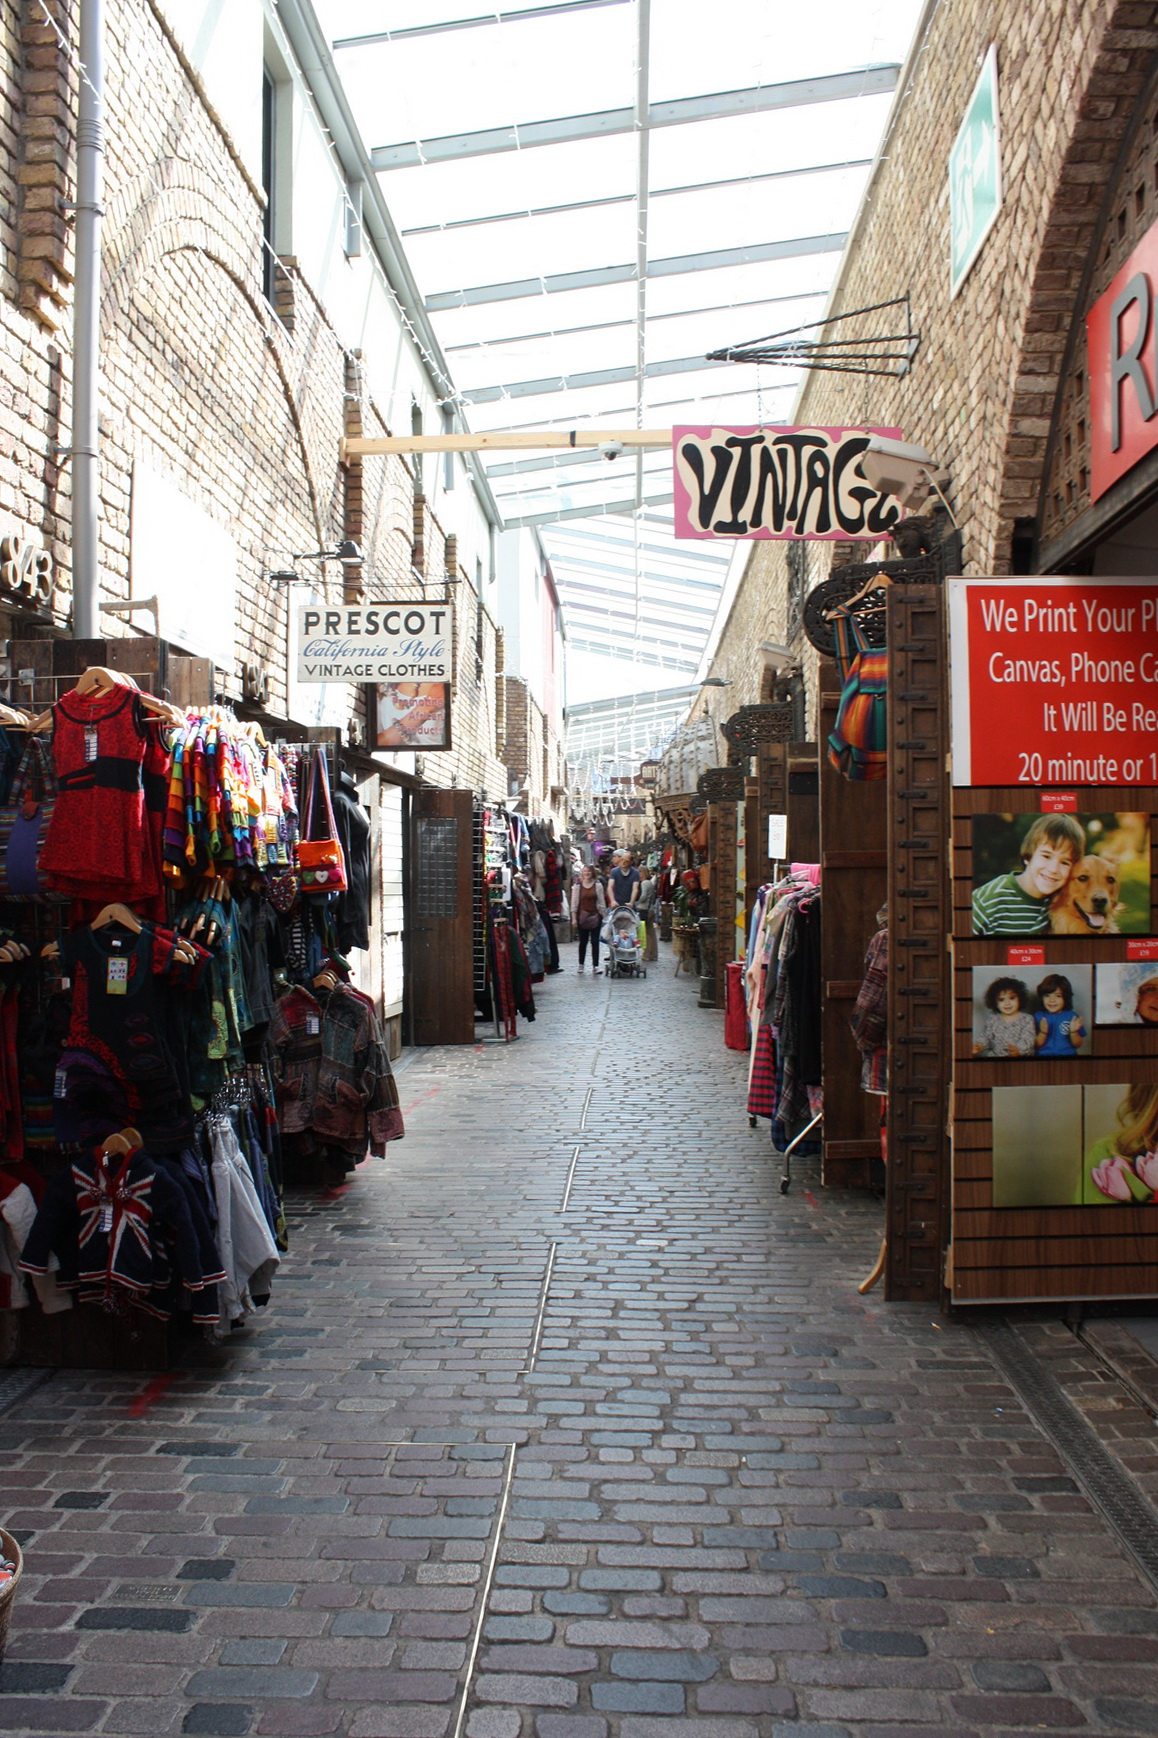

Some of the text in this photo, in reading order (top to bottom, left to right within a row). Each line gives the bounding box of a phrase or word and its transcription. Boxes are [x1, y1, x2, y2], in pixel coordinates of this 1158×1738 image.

[1109, 271, 1158, 454] R
[3, 534, 53, 600] 843
[303, 610, 446, 636] PRESCOT
[980, 599, 1018, 632] We
[1024, 598, 1077, 632] Print
[1082, 599, 1136, 632] Your
[303, 638, 446, 662] California Style
[304, 664, 445, 676] VINTAGE CLOTHES
[989, 652, 1066, 687] Canvas,
[1071, 652, 1135, 682] Phone
[1043, 701, 1158, 732] It Will Be Re
[1018, 753, 1043, 781] 20
[1048, 752, 1118, 781] minute
[1122, 758, 1144, 781] or
